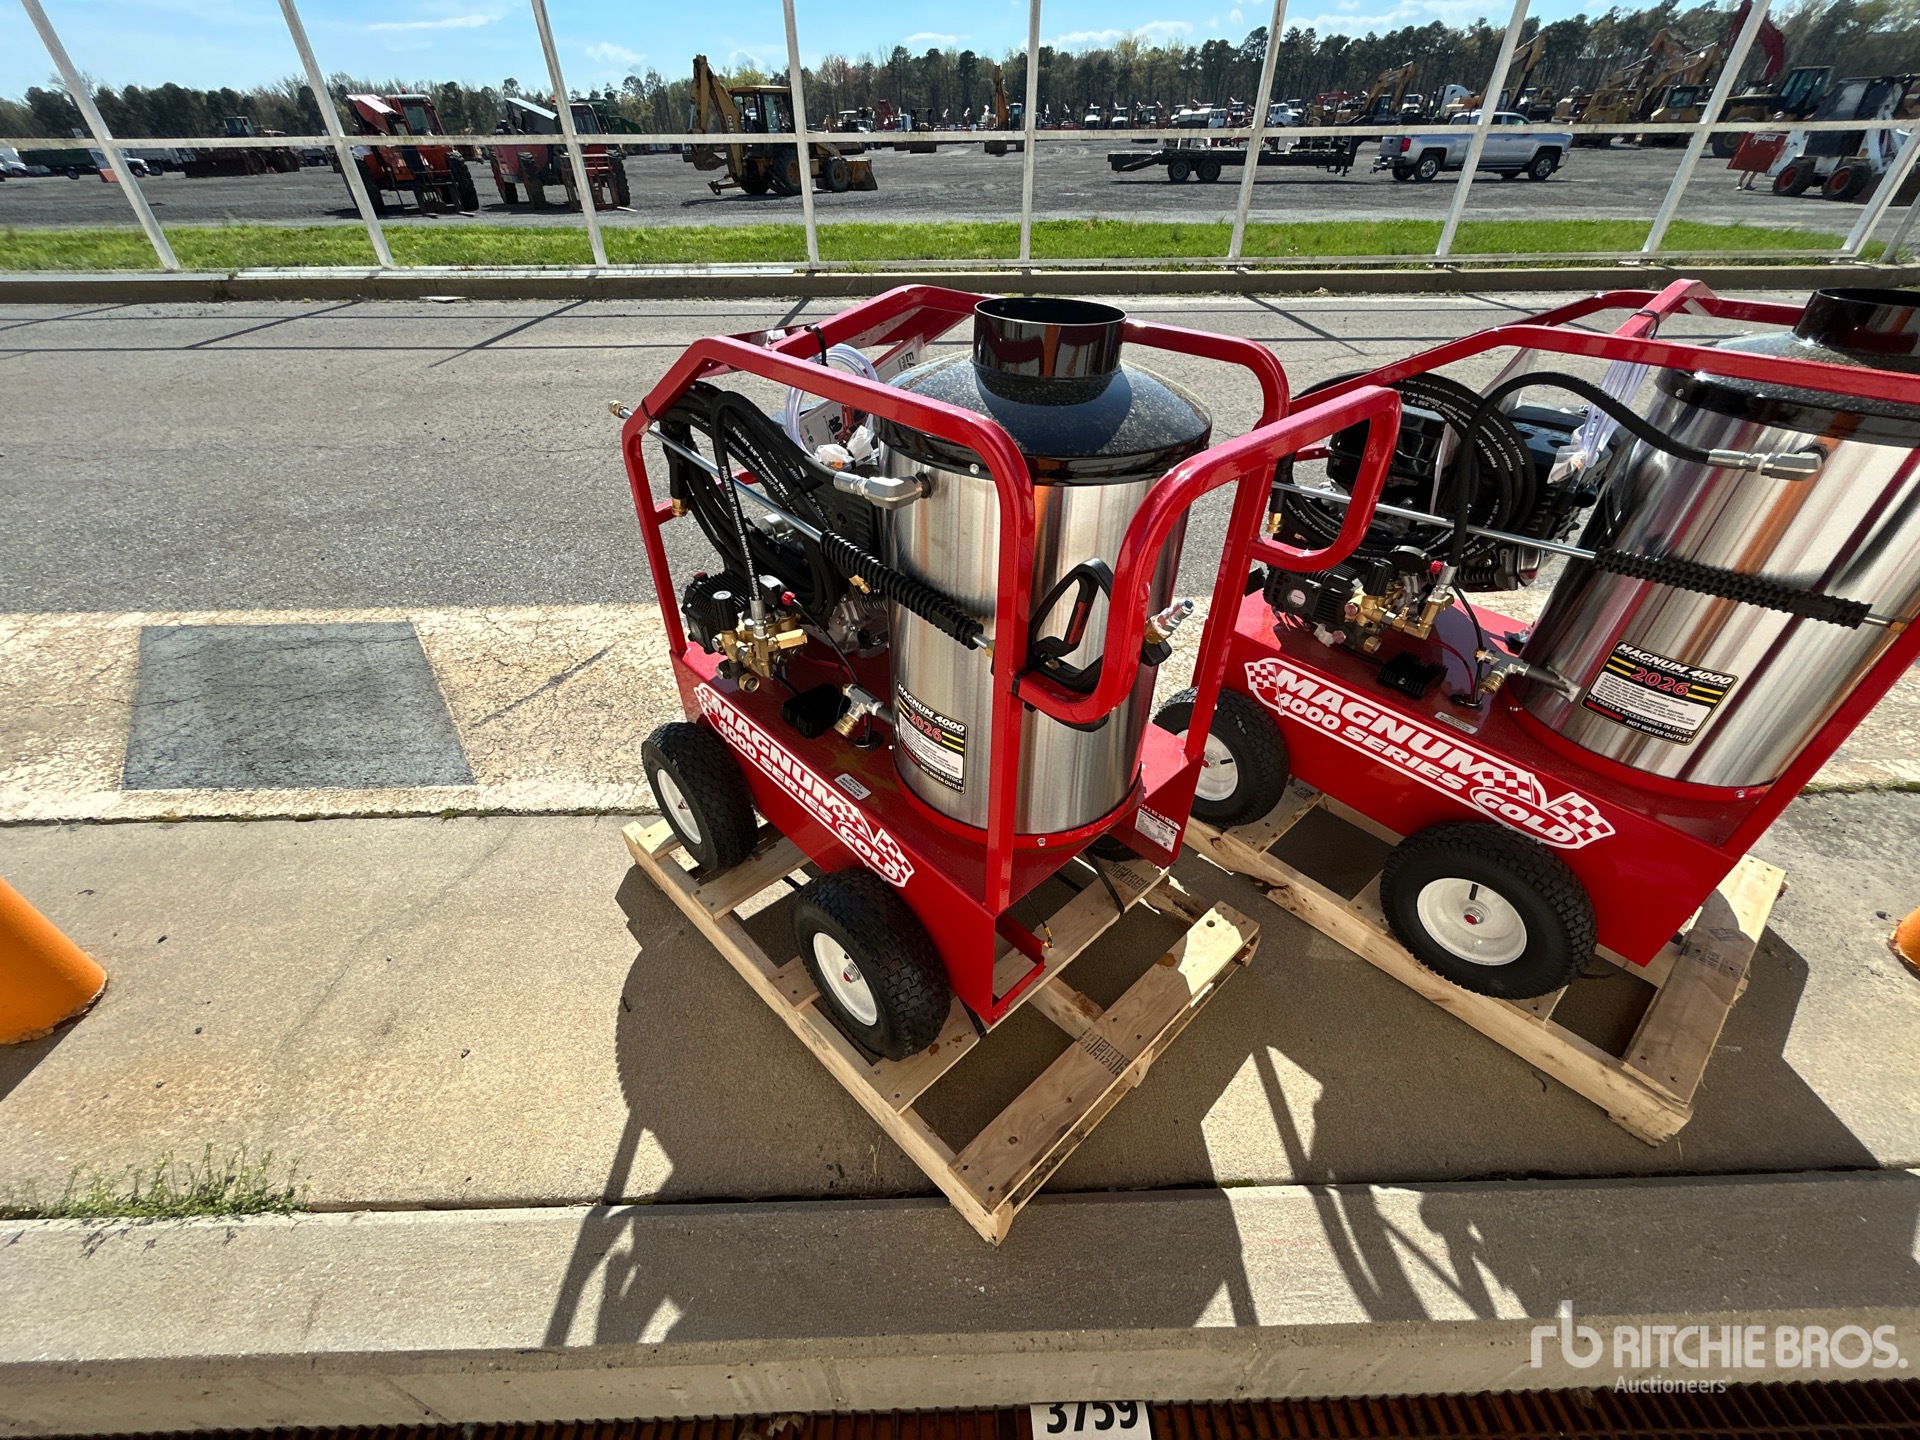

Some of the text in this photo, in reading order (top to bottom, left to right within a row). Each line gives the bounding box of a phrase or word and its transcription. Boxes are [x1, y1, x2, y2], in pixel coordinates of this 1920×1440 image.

[732, 426, 750, 447] PROJET
[758, 457, 779, 483] Pressure
[721, 466, 732, 491] PROJET
[732, 505, 743, 534] Pressure
[740, 534, 750, 558] Washer
[747, 559, 755, 577] Hose
[751, 577, 759, 600] 4500PS
[1617, 643, 1734, 684] MAGNUM 4000
[1629, 655, 1652, 667] WATER
[1653, 665, 1690, 678] PRESSURE
[1630, 667, 1692, 695] 2026
[898, 683, 934, 718] MAGNUM
[935, 715, 965, 732] 4000
[909, 709, 942, 742] 2026
[1274, 668, 1483, 783] MAGNUM
[1586, 694, 1597, 704] ALL
[1597, 698, 1615, 710] PARTS
[1621, 708, 1662, 727] ACCESSORIES
[1672, 725, 1694, 736] STOCK
[1626, 719, 1691, 743] HOT WATER OUTLET
[711, 697, 840, 807] MAGNUM
[1274, 692, 1468, 790] 4000 SERIES
[718, 719, 833, 824] 4000 SERIES
[946, 772, 963, 785] STOCK
[1475, 791, 1577, 844] GOLD
[839, 827, 898, 880] GOLD
